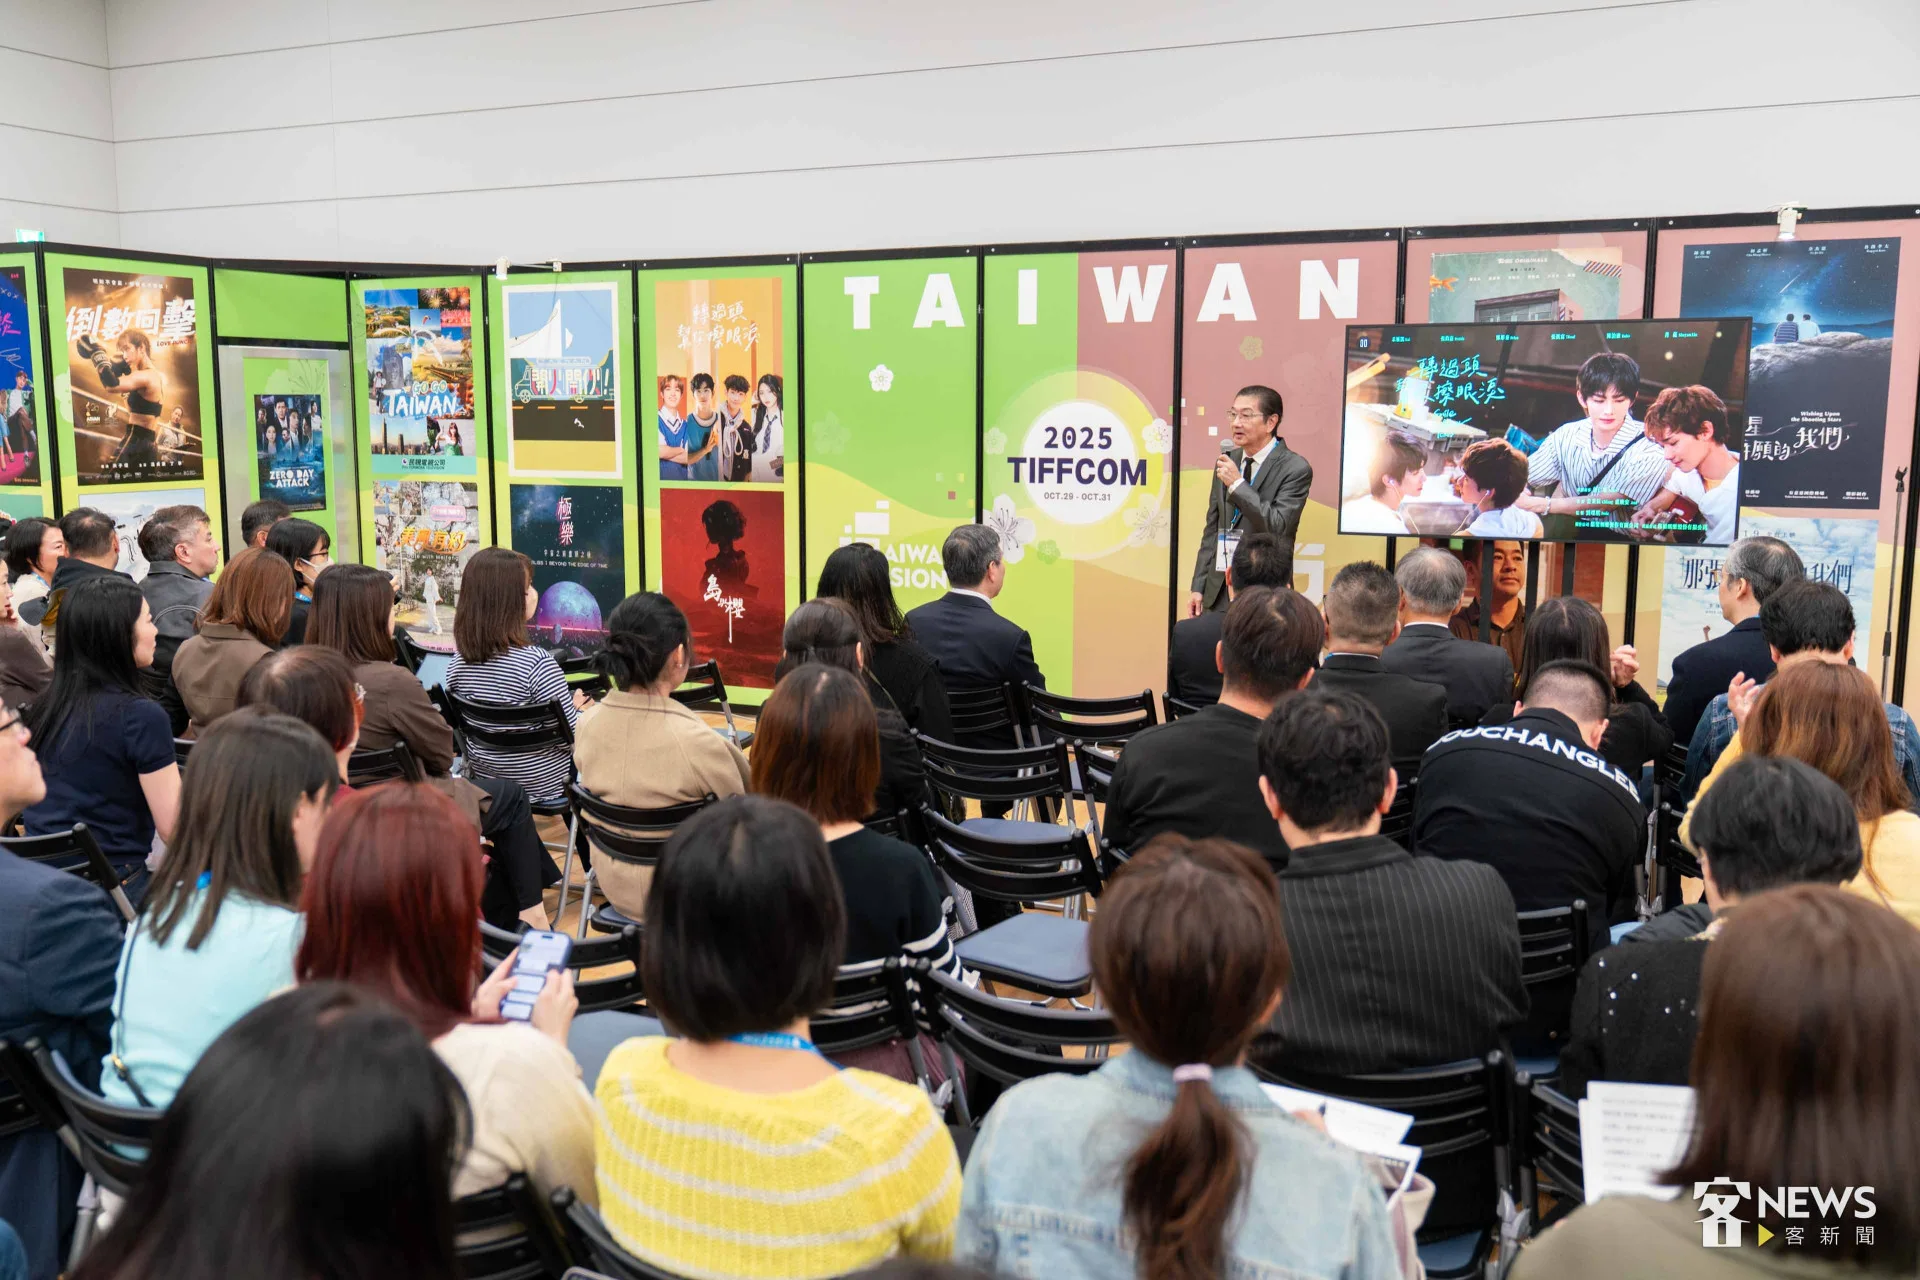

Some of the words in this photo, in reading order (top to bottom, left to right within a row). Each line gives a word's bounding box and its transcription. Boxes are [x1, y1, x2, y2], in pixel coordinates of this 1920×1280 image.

[843, 258, 1360, 331] TAIWAN
[1412, 354, 1488, 382] 轉過頭
[412, 380, 429, 394] GO
[431, 380, 448, 393] GO
[383, 389, 458, 417] TAIWAN
[1044, 426, 1113, 450] 2025
[269, 470, 294, 480] ZERO
[296, 468, 314, 479] DAY
[275, 478, 310, 488] ATTACK
[1007, 457, 1148, 486] TIFFCOM
[1044, 492, 1074, 500] OCT.29
[1081, 492, 1111, 501] OCT.31
[557, 495, 574, 546] 極樂
[885, 543, 945, 565] AIWA
[889, 567, 949, 589] SION
